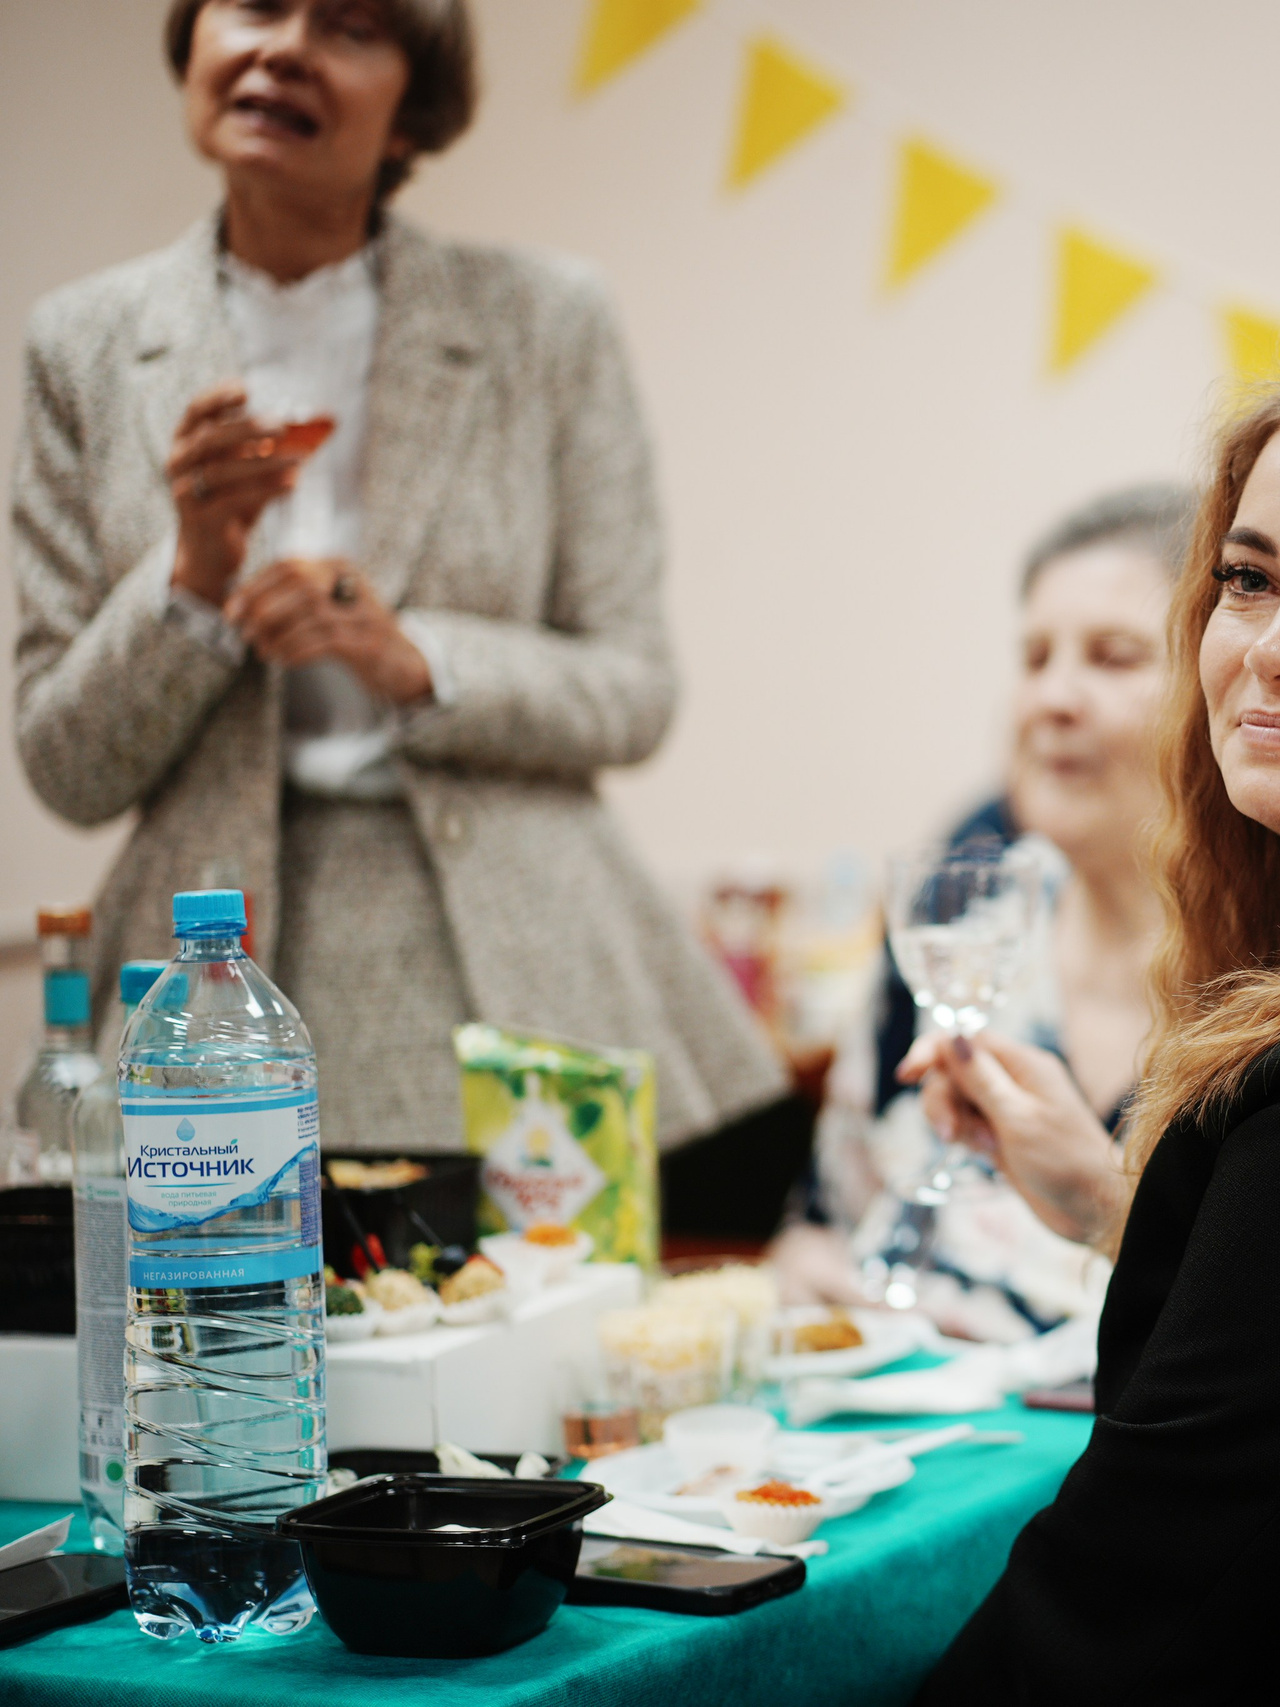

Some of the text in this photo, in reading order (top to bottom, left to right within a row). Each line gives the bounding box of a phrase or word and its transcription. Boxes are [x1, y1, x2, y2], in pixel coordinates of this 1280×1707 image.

[140, 1140, 239, 1158] Кристальный
[127, 1156, 255, 1179] Источник
[161, 1190, 217, 1200] вода питьевая
[168, 1199, 212, 1208] природная
[143, 1268, 245, 1281] НЕГАЗИРОВАННАЯ
